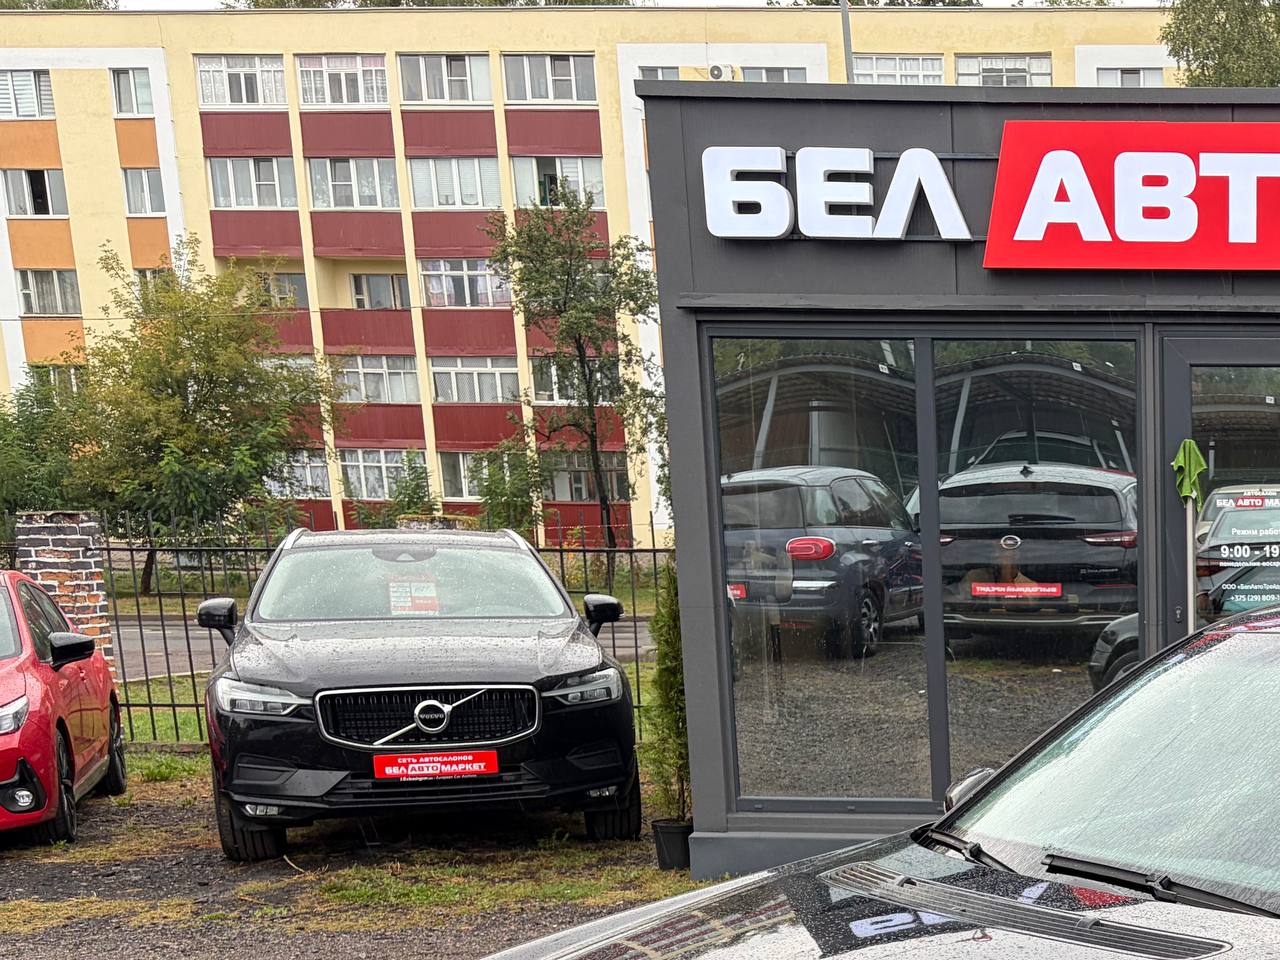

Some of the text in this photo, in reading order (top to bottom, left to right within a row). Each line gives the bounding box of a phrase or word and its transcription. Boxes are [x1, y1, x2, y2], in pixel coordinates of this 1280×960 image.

[701, 146, 972, 241] БЕЛ
[1216, 499, 1236, 507] БЕЛ
[1220, 545, 1251, 558] 9:00
[385, 766, 407, 774] БЕЛ
[441, 763, 487, 772] МАРКЕТ
